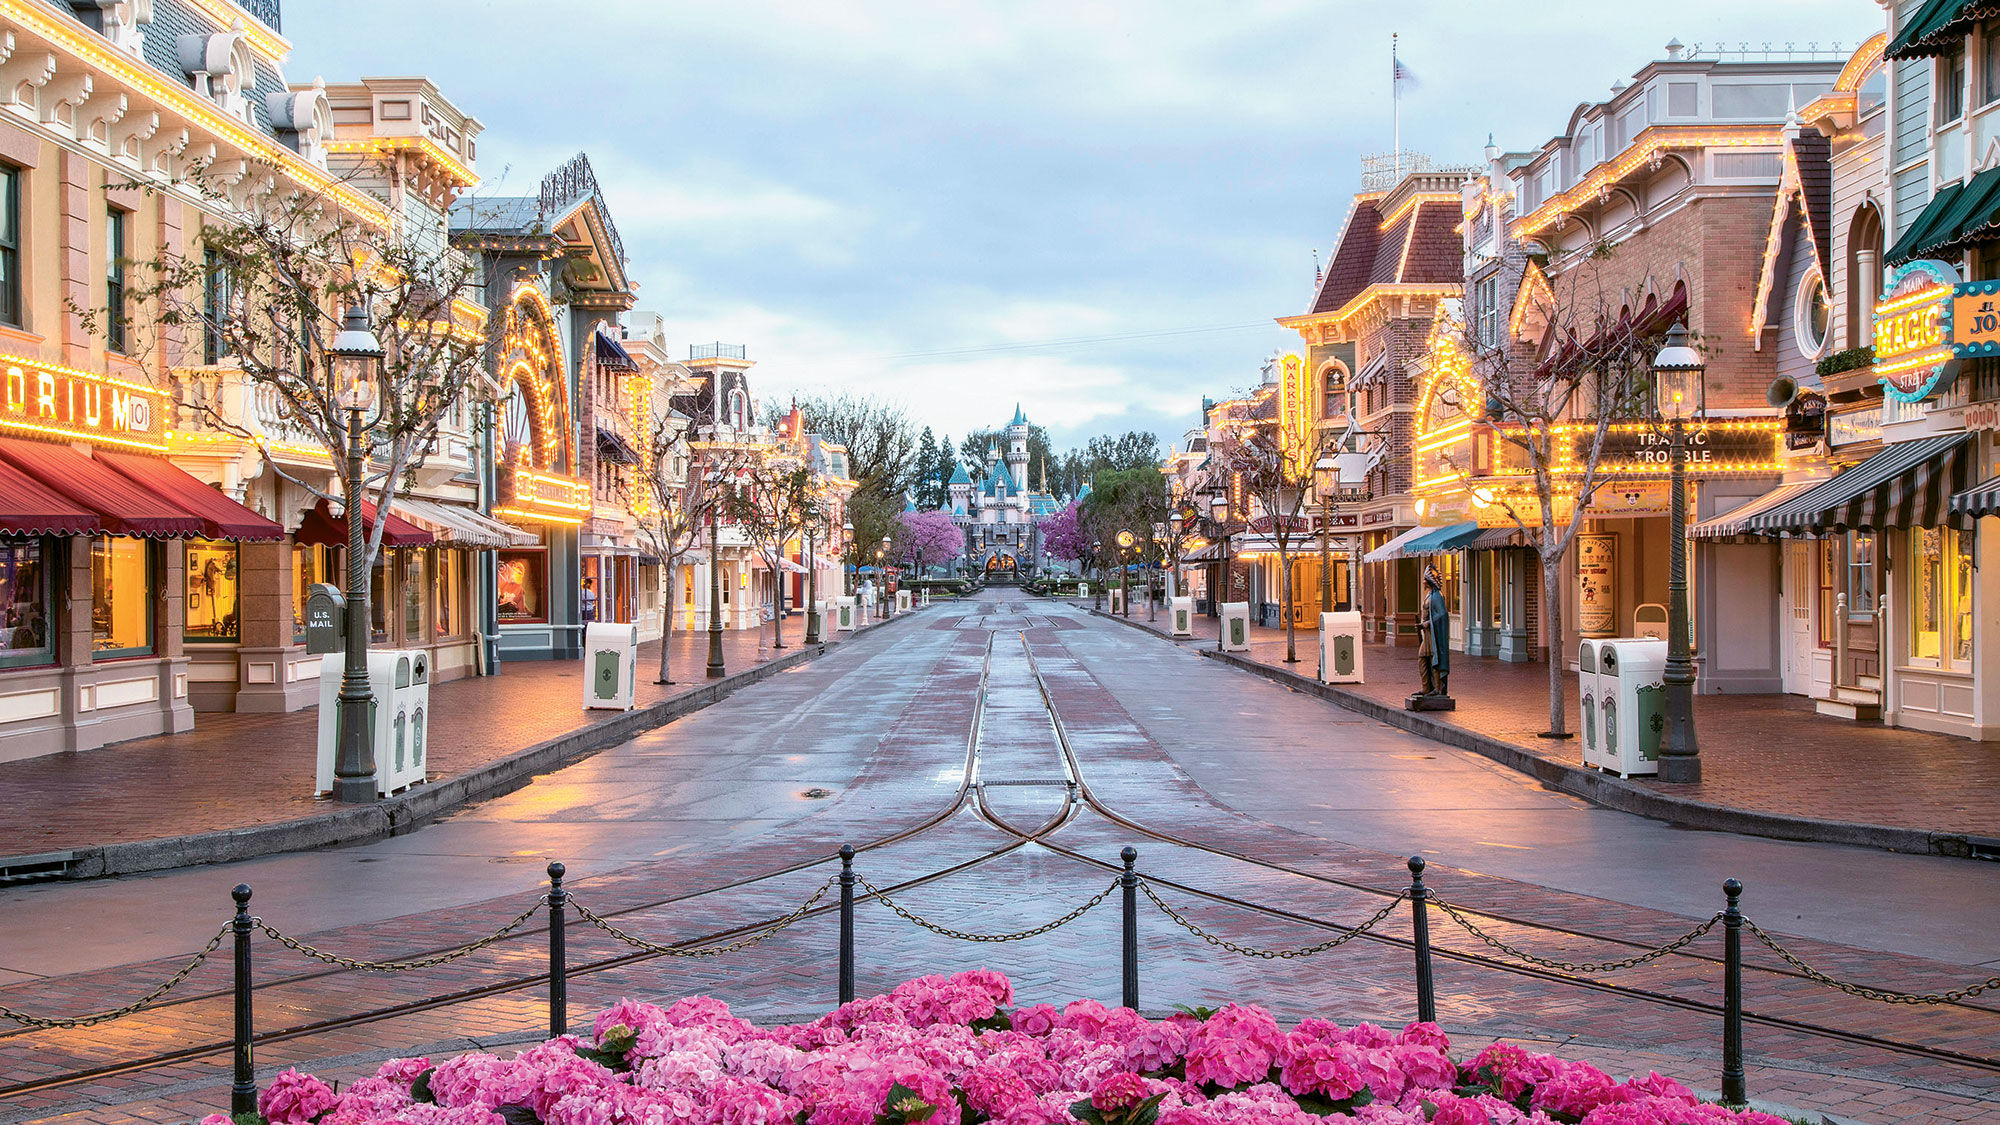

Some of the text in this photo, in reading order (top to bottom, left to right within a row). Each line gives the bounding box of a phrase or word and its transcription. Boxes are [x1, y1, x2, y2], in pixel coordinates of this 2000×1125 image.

[1903, 276, 1924, 294] MAIN
[1876, 304, 1940, 357] MAGIC
[1970, 311, 2000, 334] JO
[1900, 370, 1925, 388] STREET
[1286, 363, 1296, 417] MARKET
[131, 403, 148, 425] 101
[1637, 433, 1706, 446] TRAIC
[1635, 450, 1711, 463] TROBLE
[310, 620, 333, 628] MAIL
[314, 611, 330, 619] U.S.
